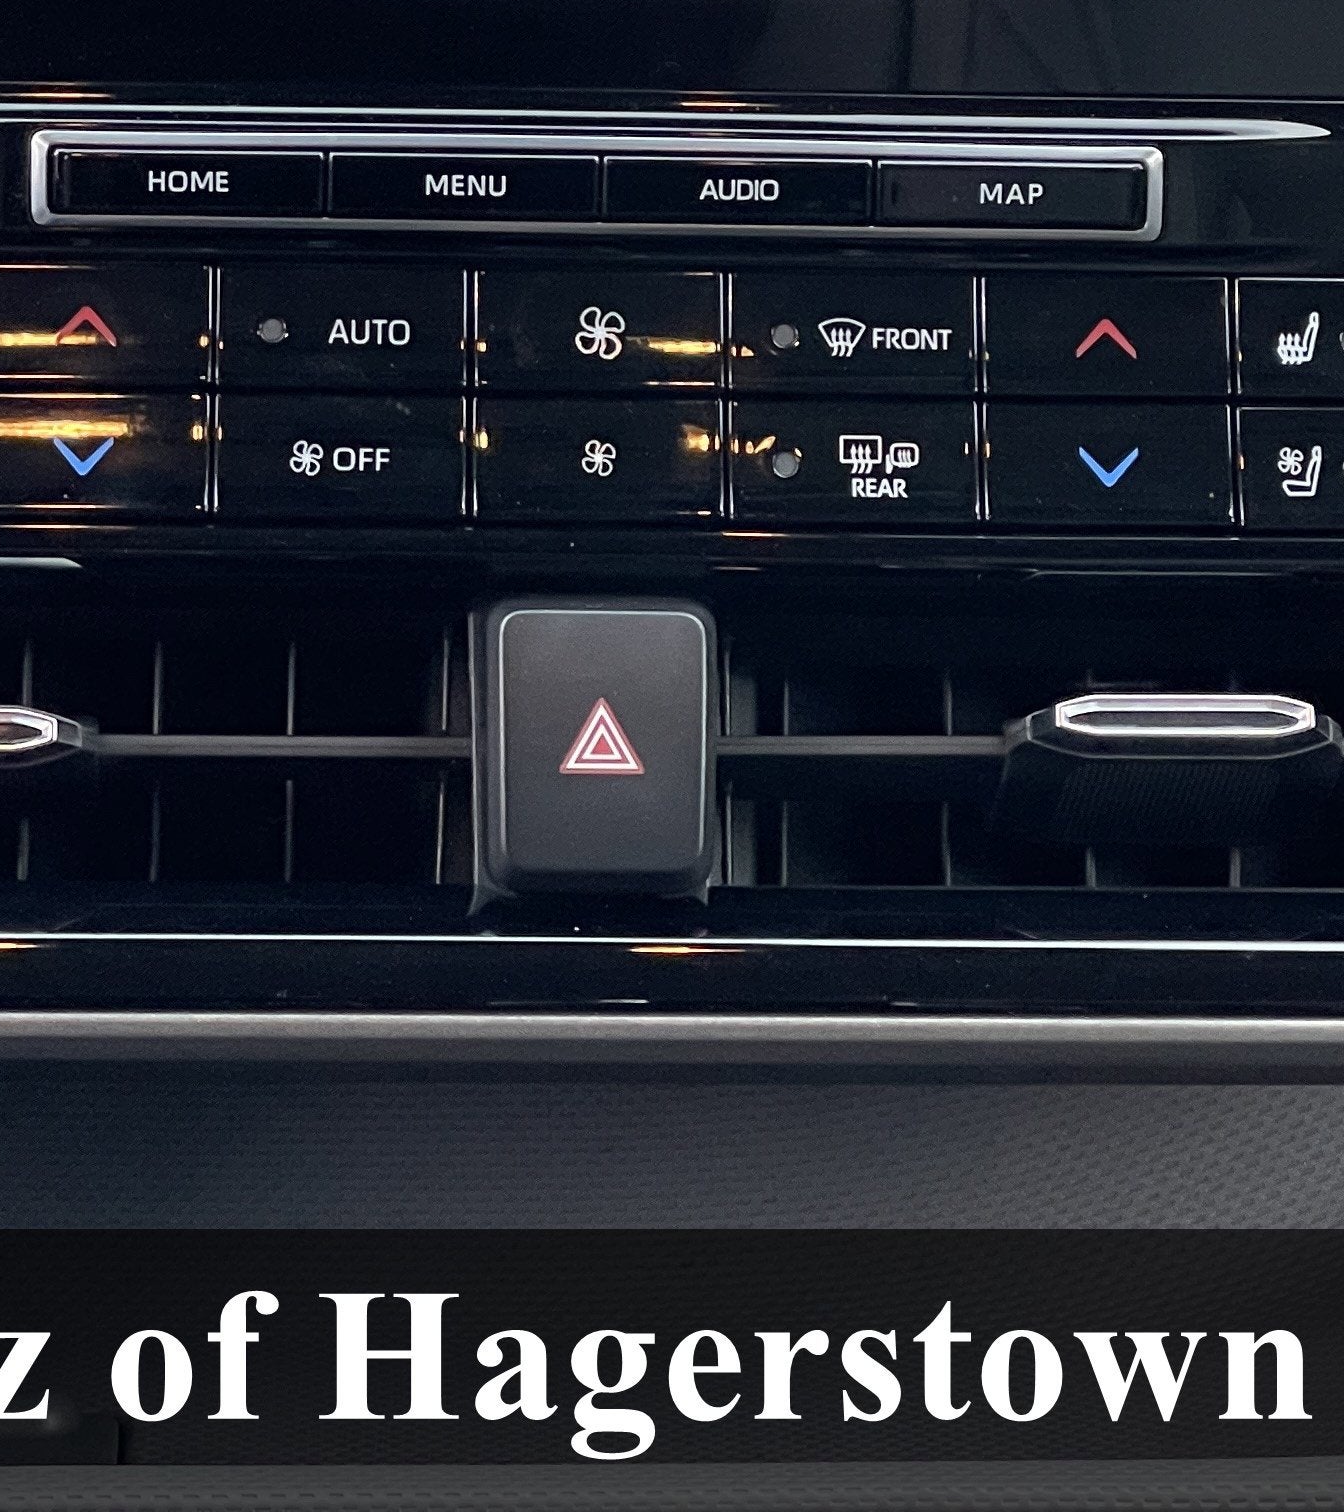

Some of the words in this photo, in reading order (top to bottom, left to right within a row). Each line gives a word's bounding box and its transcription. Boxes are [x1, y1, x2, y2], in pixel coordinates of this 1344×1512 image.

[148, 170, 229, 193] HOME
[425, 174, 507, 197] MENU
[699, 178, 779, 201] AUDIO
[979, 182, 1043, 205] MAP
[328, 318, 411, 346] AUTO
[872, 327, 953, 351] FRONT
[332, 446, 391, 472] OFF
[851, 477, 909, 499] REAR
